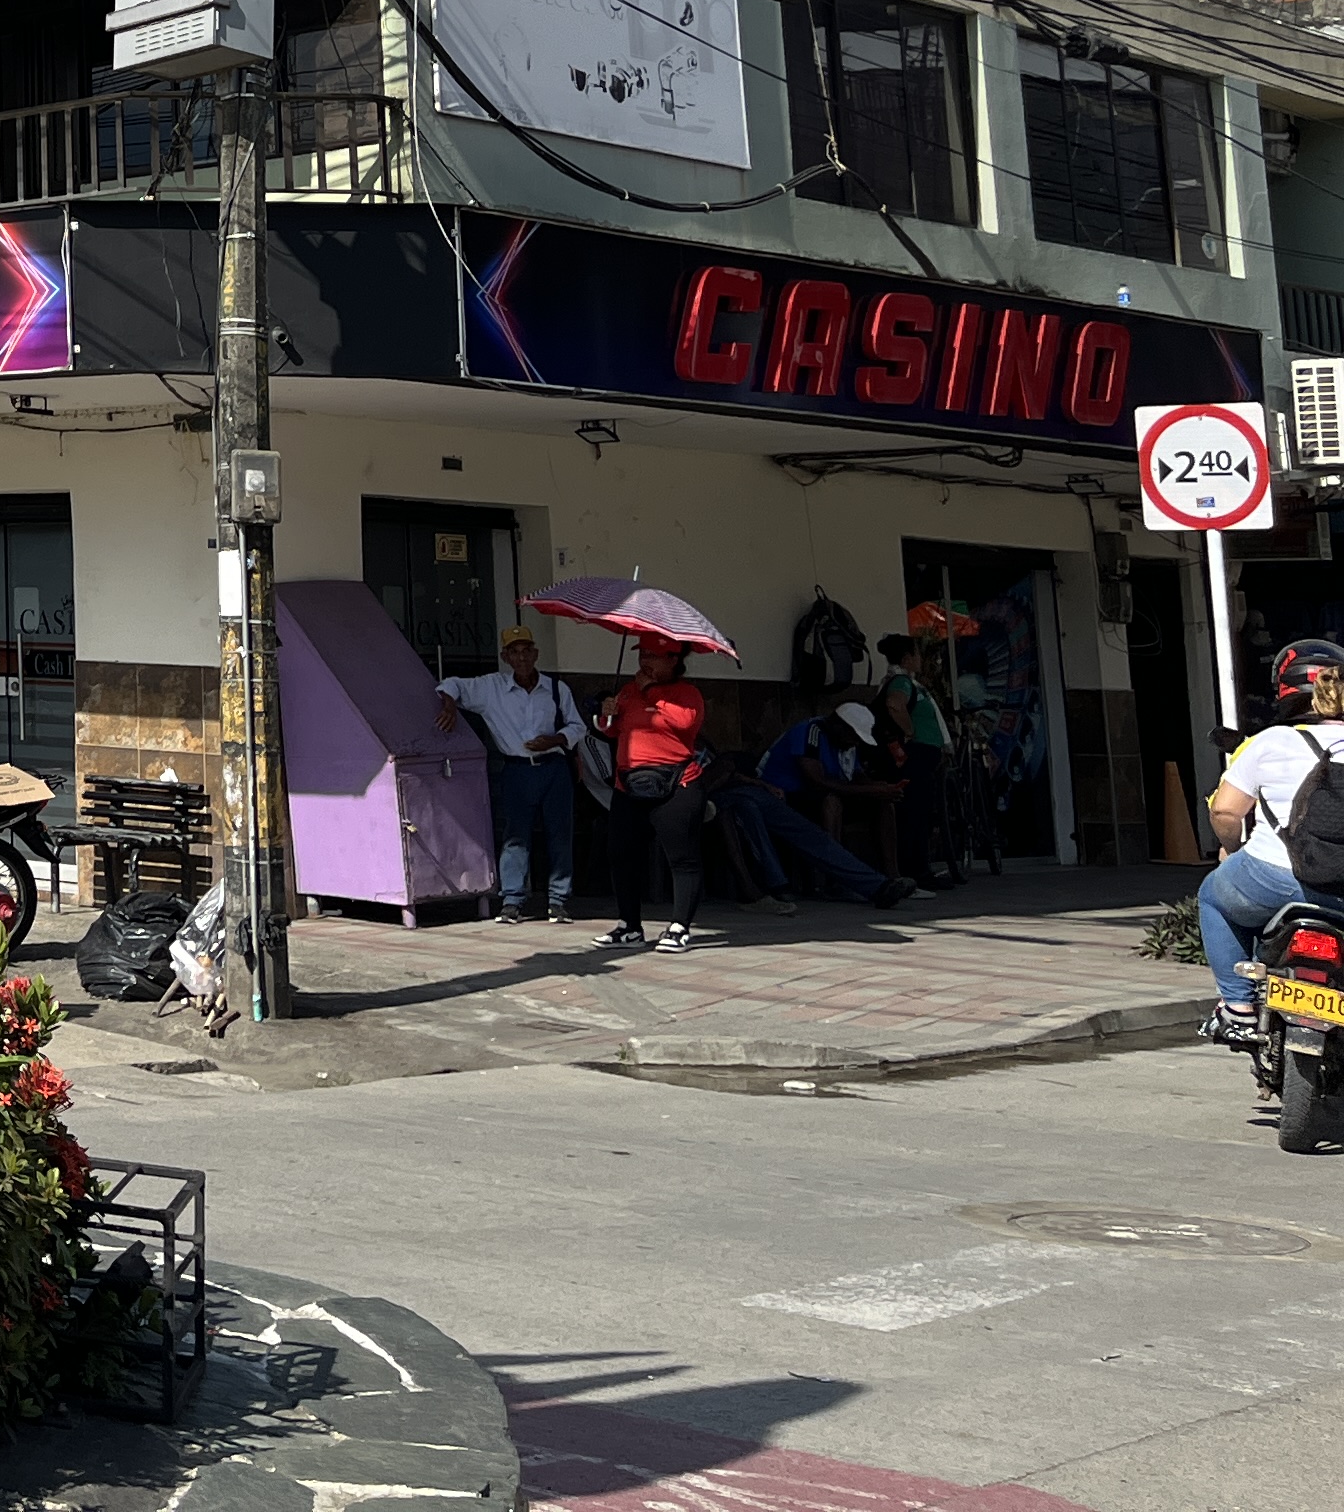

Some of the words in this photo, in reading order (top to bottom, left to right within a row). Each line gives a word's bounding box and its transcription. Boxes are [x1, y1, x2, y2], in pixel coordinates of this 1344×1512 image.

[674, 265, 1131, 427] CASINO
[34, 653, 64, 676] Cash
[1269, 982, 1306, 1005] PPP
